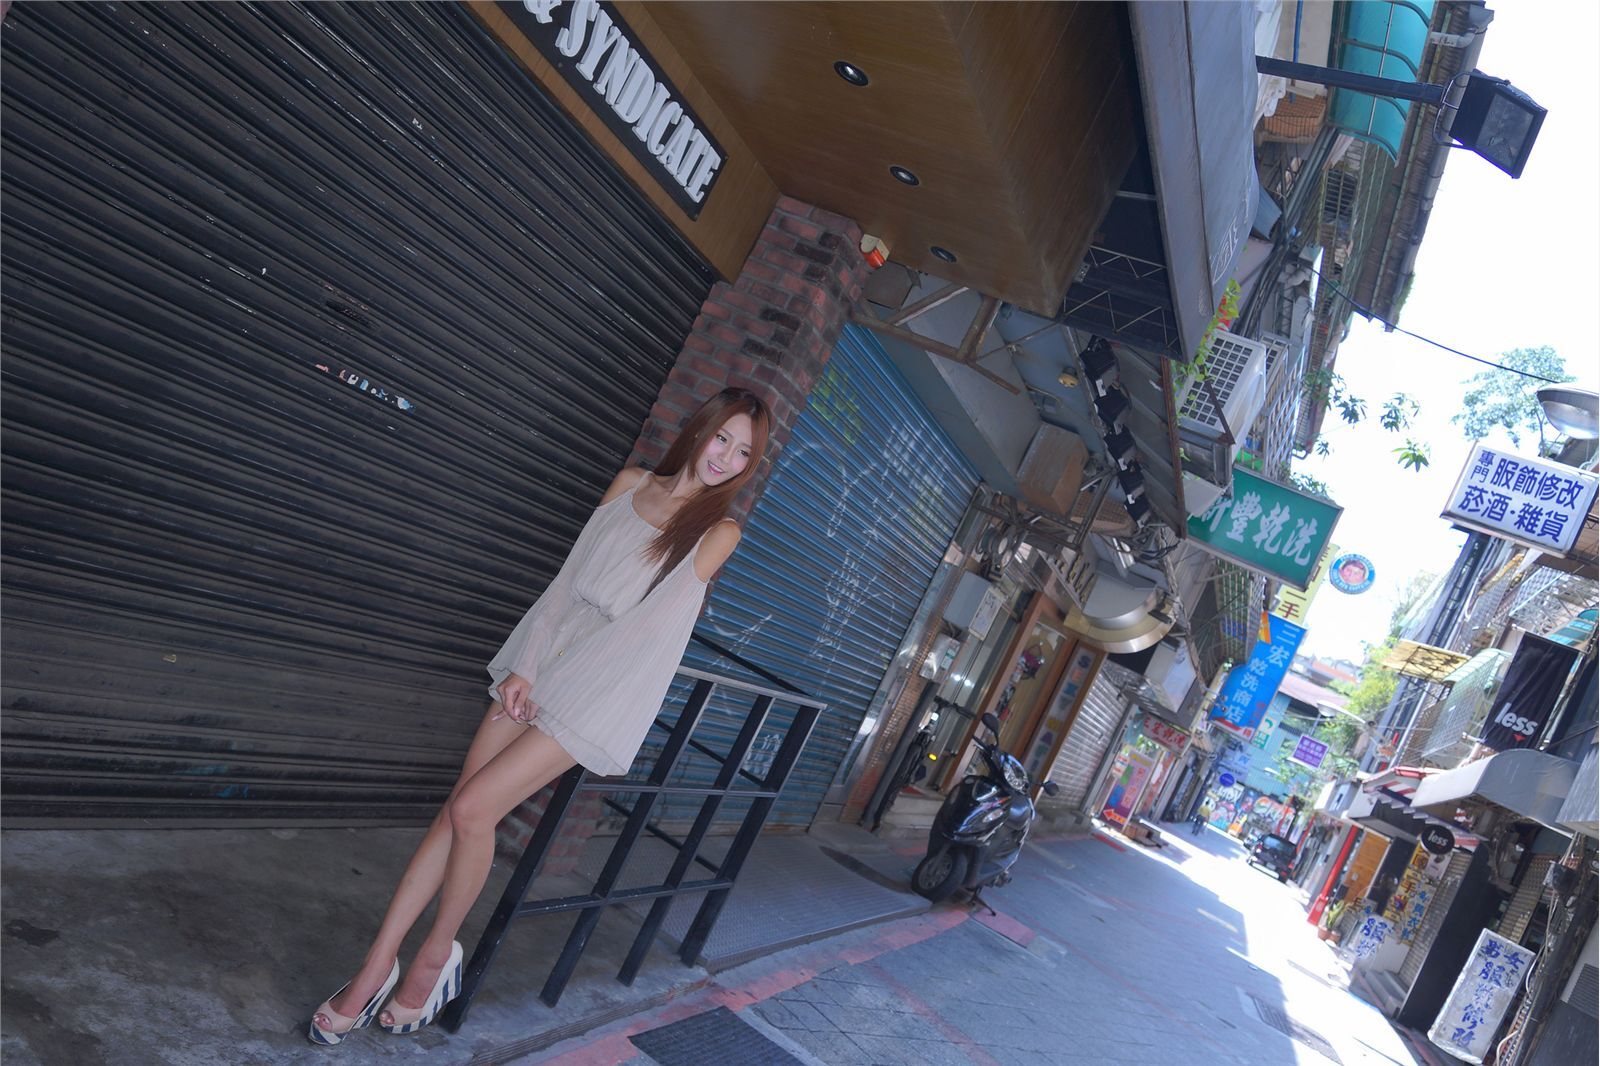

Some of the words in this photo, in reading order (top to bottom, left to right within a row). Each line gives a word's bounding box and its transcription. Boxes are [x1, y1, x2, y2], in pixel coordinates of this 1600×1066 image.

[555, 1, 721, 204] SYNDICATE
[1490, 457, 1584, 510] 服飾修改
[1494, 702, 1538, 736] less
[1427, 830, 1449, 846] less
